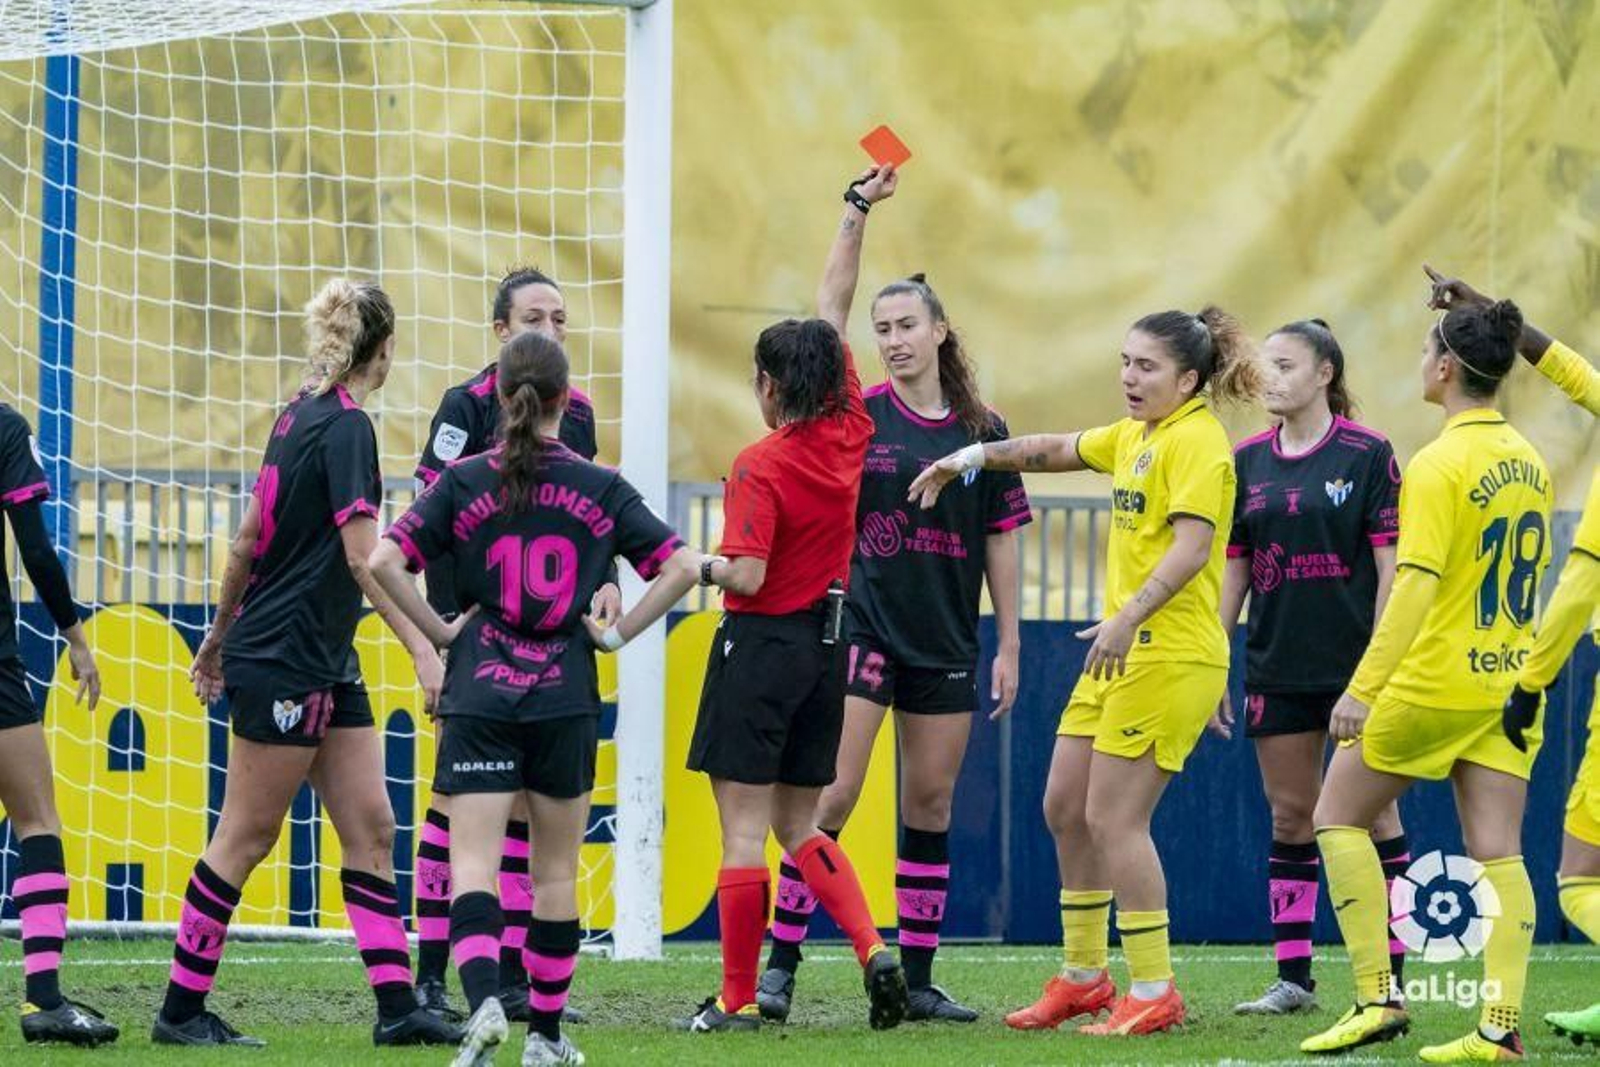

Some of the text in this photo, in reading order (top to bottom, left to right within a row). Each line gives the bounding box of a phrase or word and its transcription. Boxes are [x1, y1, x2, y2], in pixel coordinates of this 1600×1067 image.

[486, 534, 579, 630] 19
[1475, 510, 1545, 629] 18
[452, 760, 515, 773] ROMERO
